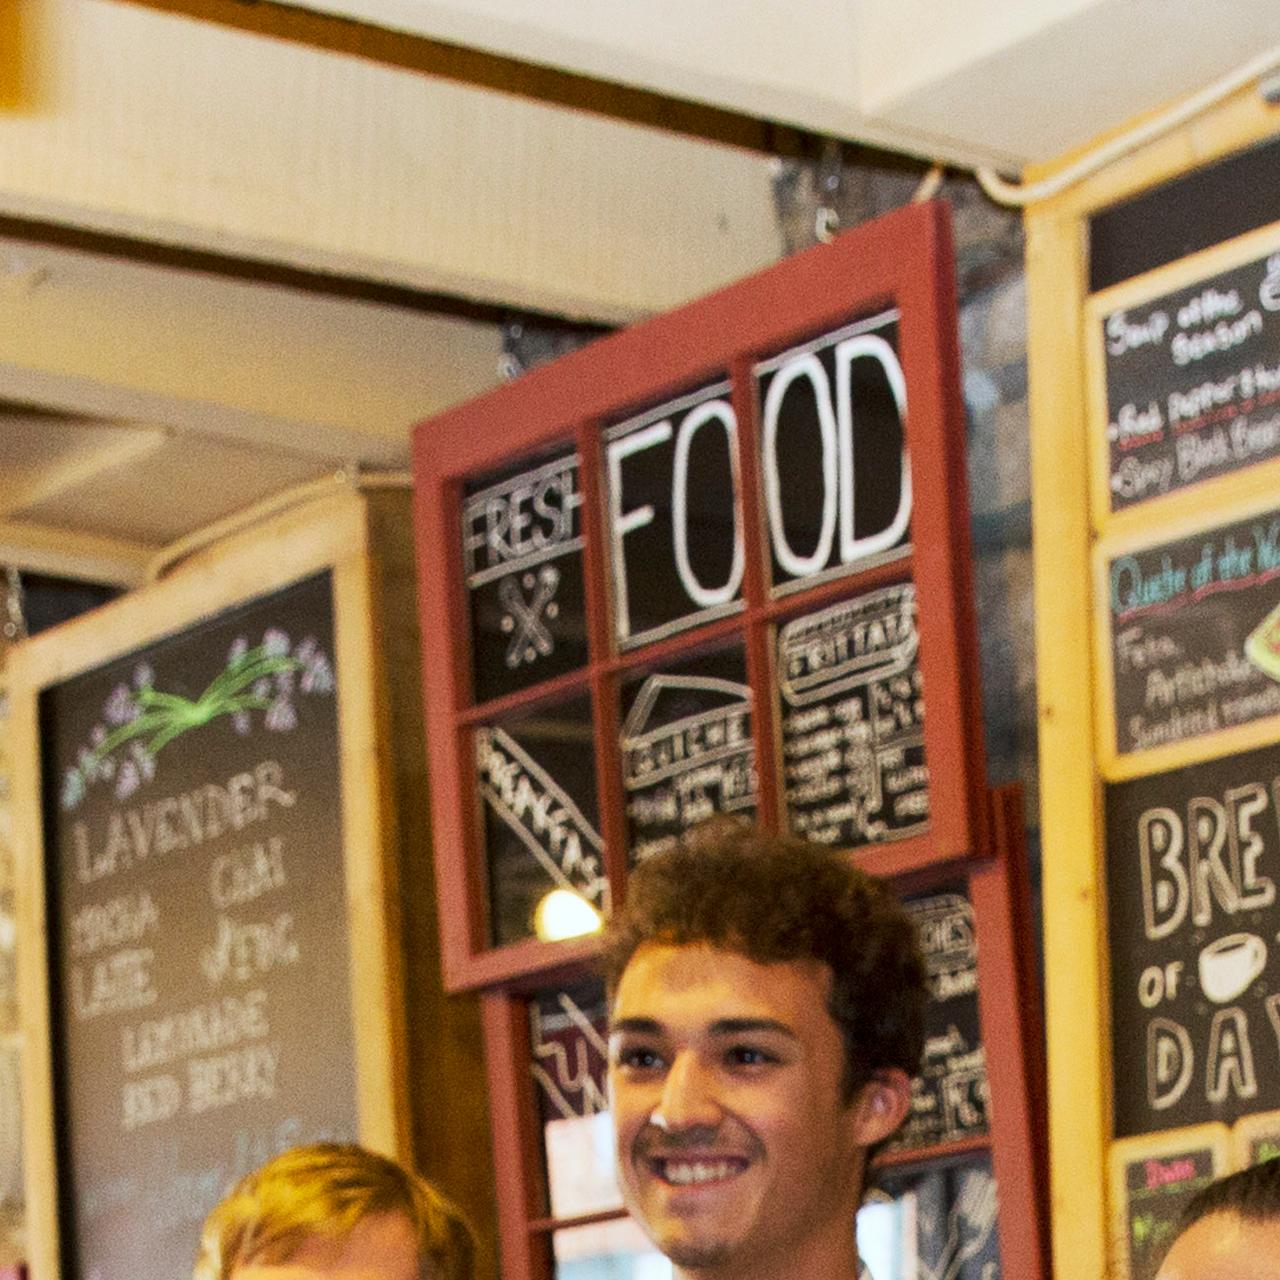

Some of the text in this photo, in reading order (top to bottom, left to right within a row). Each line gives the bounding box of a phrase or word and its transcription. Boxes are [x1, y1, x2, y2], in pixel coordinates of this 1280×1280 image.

[463, 333, 913, 640] FRESH FOOD
[73, 759, 298, 885] LAVENDER
[1139, 961, 1184, 1009] OF
